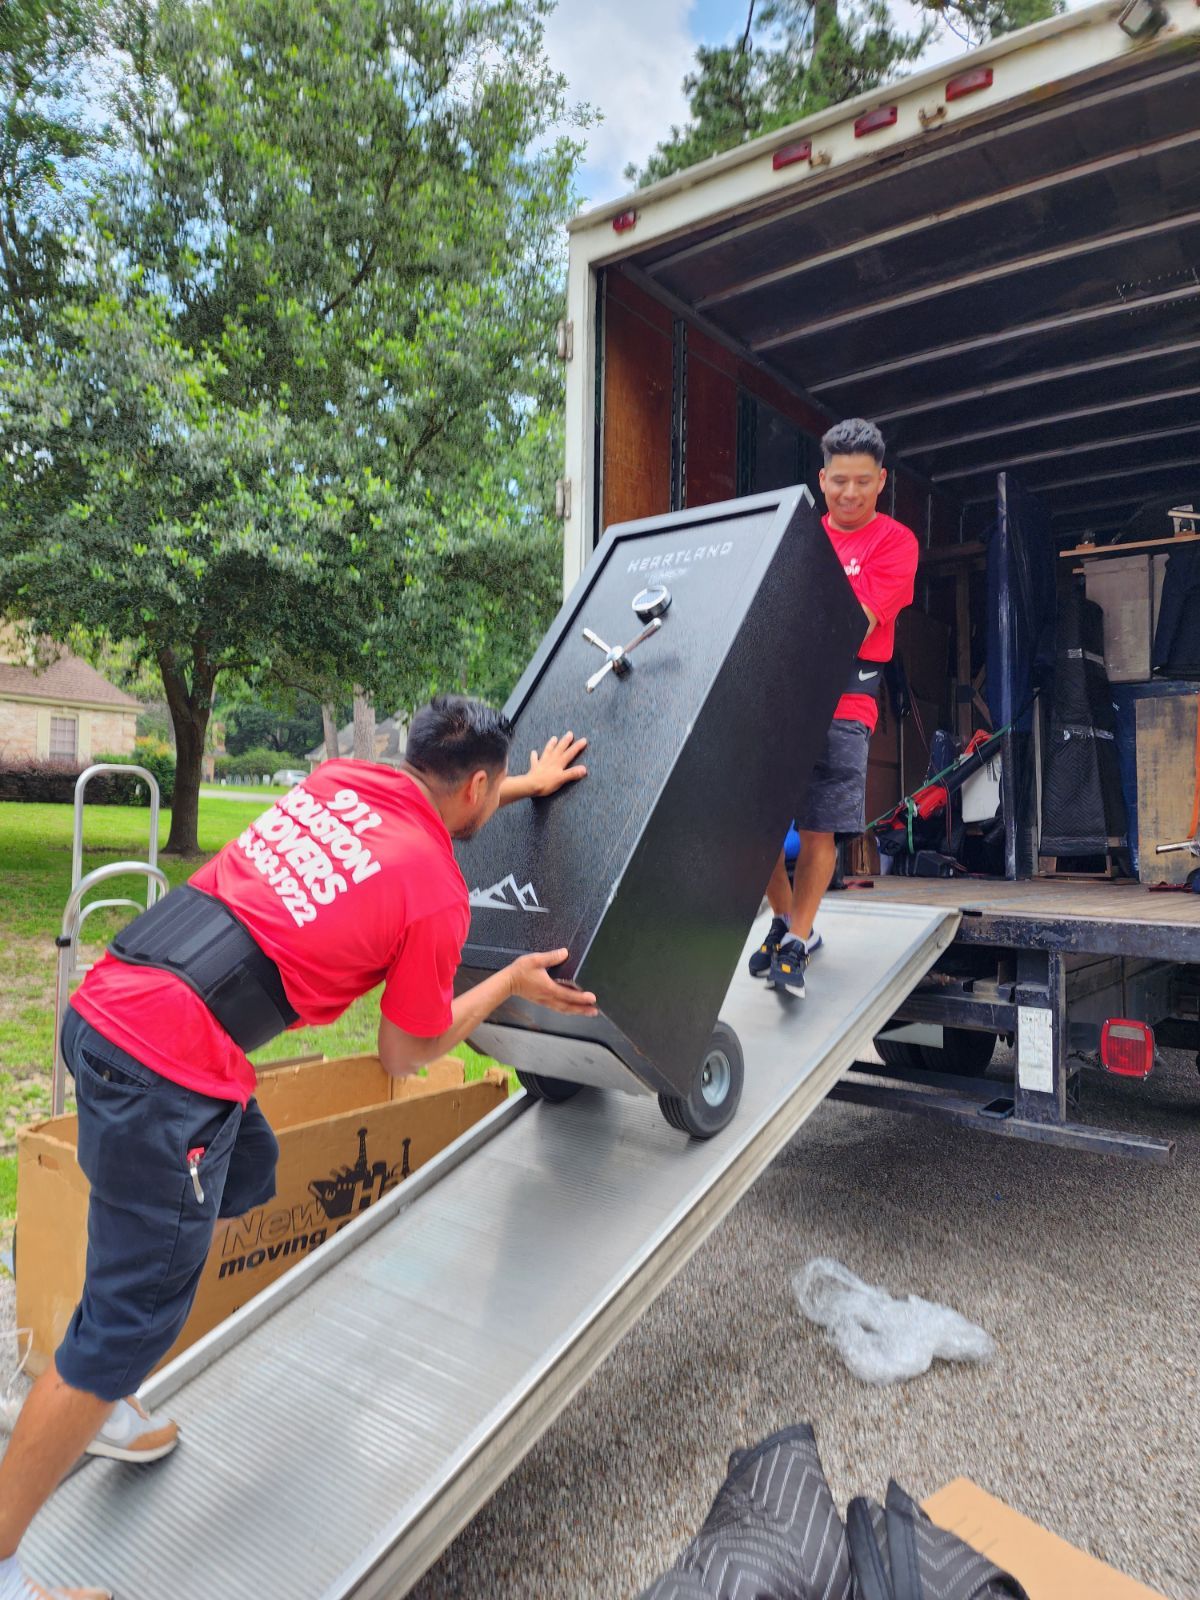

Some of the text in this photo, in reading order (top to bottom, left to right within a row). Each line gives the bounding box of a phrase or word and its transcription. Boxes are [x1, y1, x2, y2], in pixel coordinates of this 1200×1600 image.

[627, 541, 733, 573] HEARTLAND
[327, 789, 382, 835] 911
[219, 1228, 327, 1278] moving
